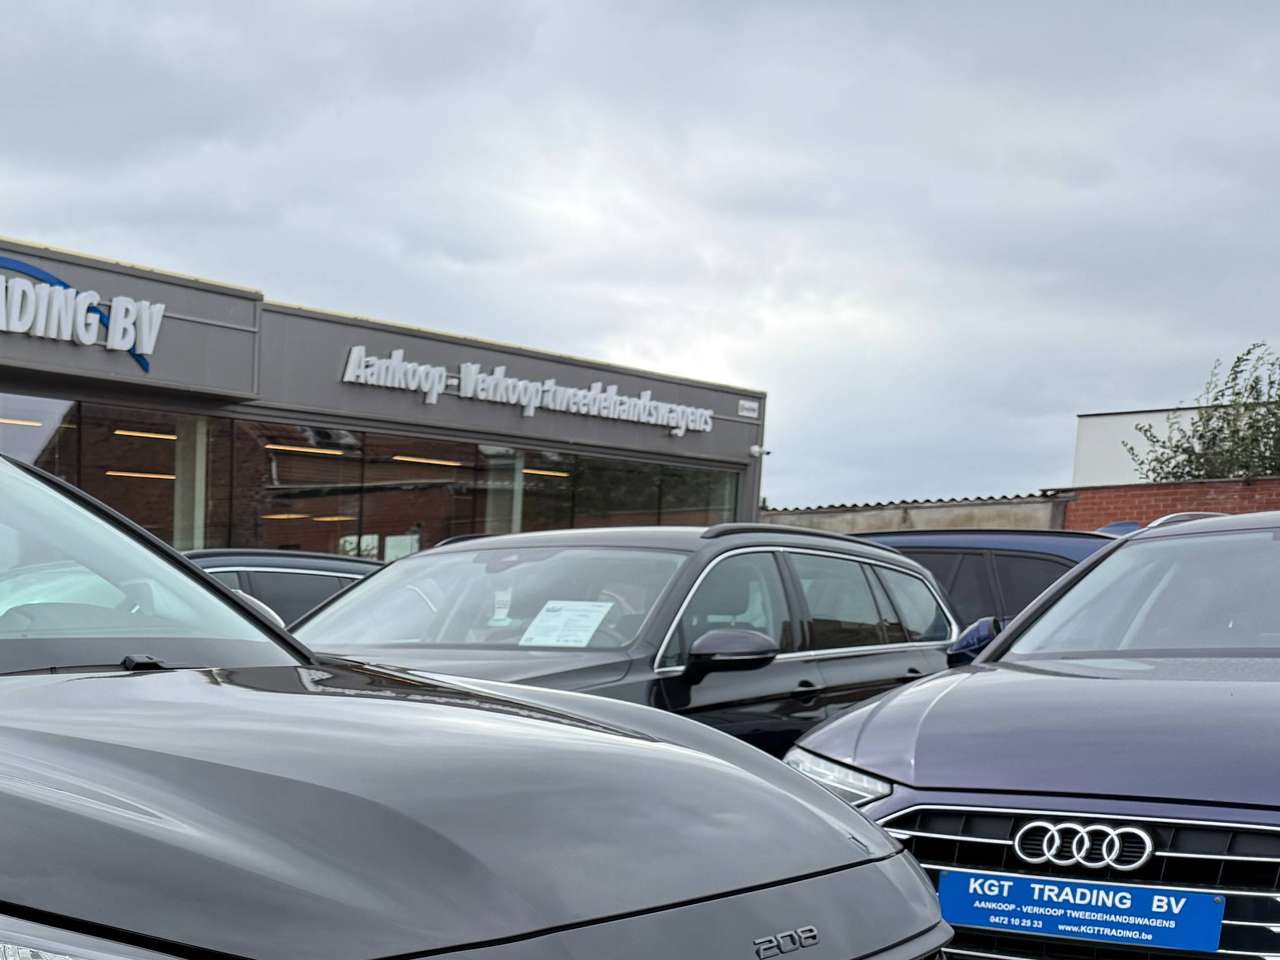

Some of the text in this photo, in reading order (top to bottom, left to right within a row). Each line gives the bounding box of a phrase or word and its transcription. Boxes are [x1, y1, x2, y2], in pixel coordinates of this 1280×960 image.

[106, 296, 165, 355] BV
[969, 878, 1186, 915] KGT TRADING BV
[973, 900, 1016, 912] AANKOOP
[1022, 905, 1065, 917] VERKOOP
[1066, 909, 1176, 929] TWEEDEHANDSWAGENS
[989, 915, 1008, 925] 0472
[1010, 917, 1020, 926] 10
[1058, 922, 1153, 941] www.KGTTRADING.be
[753, 925, 819, 960] 208
